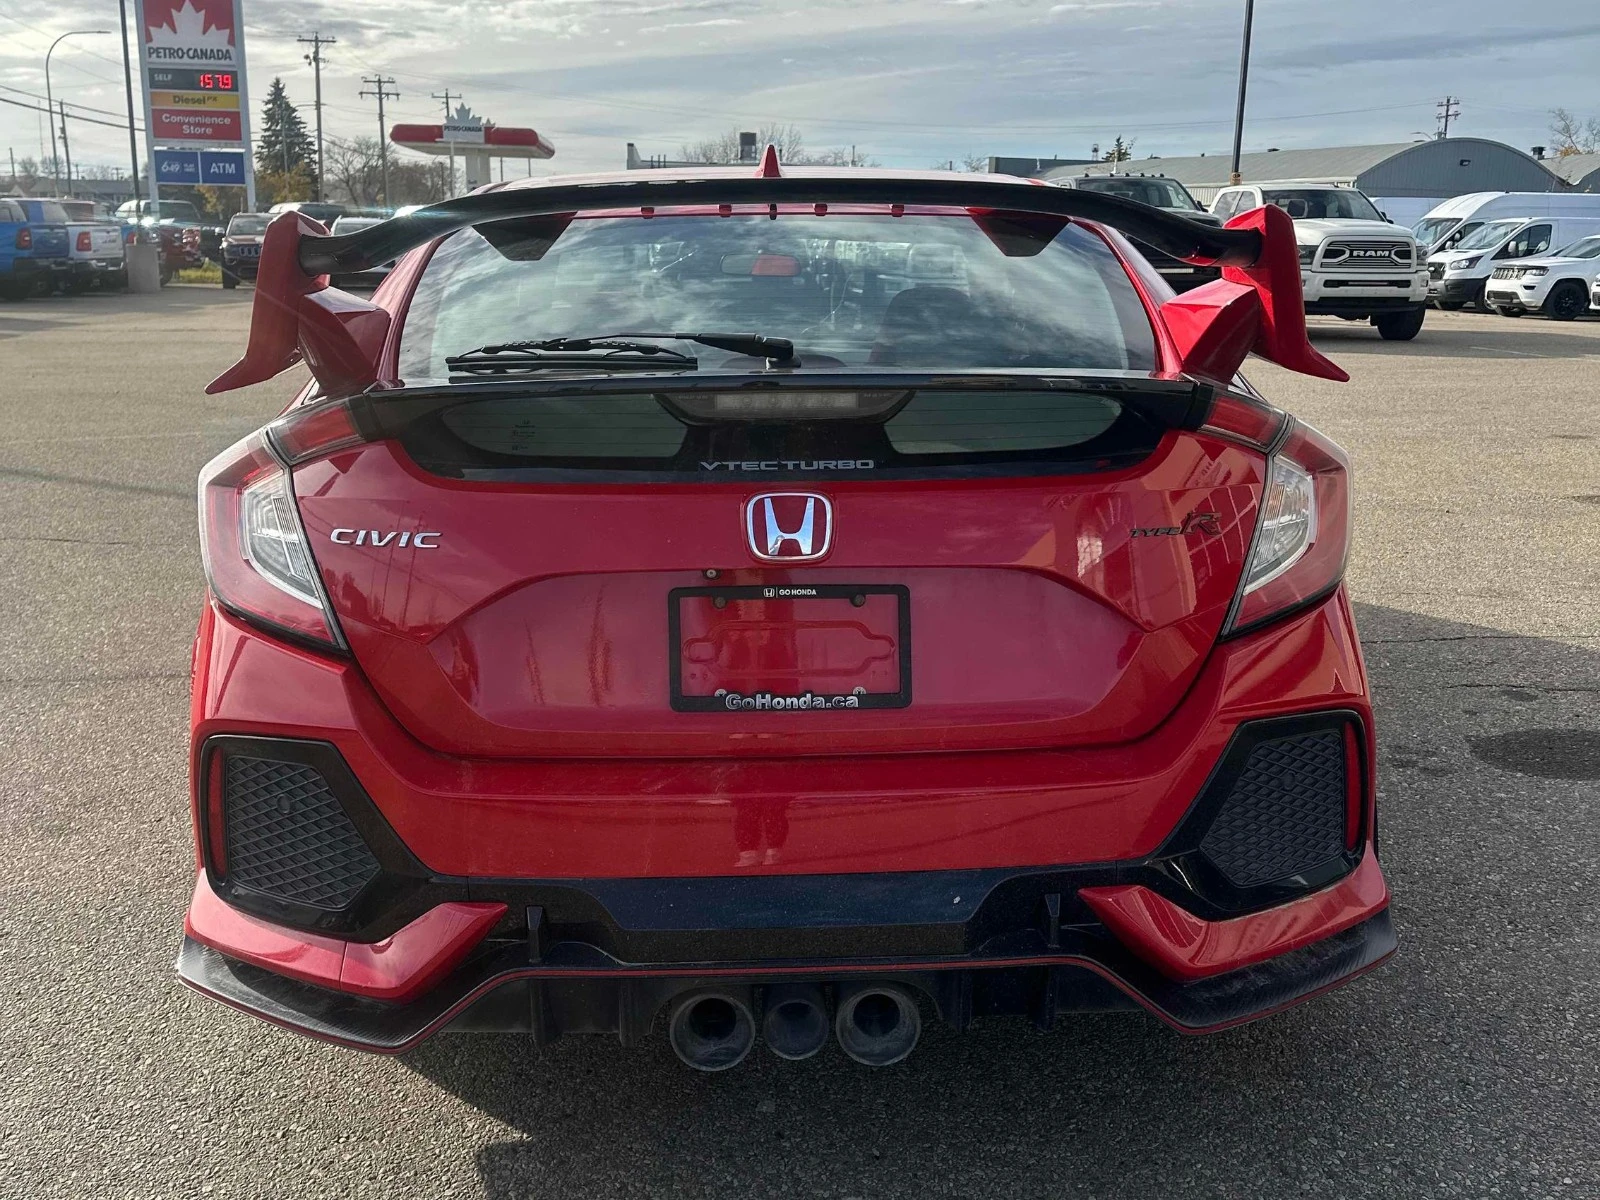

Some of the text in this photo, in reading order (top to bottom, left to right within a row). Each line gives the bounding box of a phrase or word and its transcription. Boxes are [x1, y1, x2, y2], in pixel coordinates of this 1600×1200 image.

[153, 73, 172, 81] SELF
[172, 94, 206, 105] Diesel
[161, 113, 232, 125] Convenience
[182, 124, 213, 135] Store
[210, 163, 236, 174] ATM
[700, 459, 875, 471] VTEC TURBO
[1130, 512, 1222, 538] TYPE R
[330, 528, 442, 549] CIVIC
[725, 693, 859, 710] GoHonda.ca
